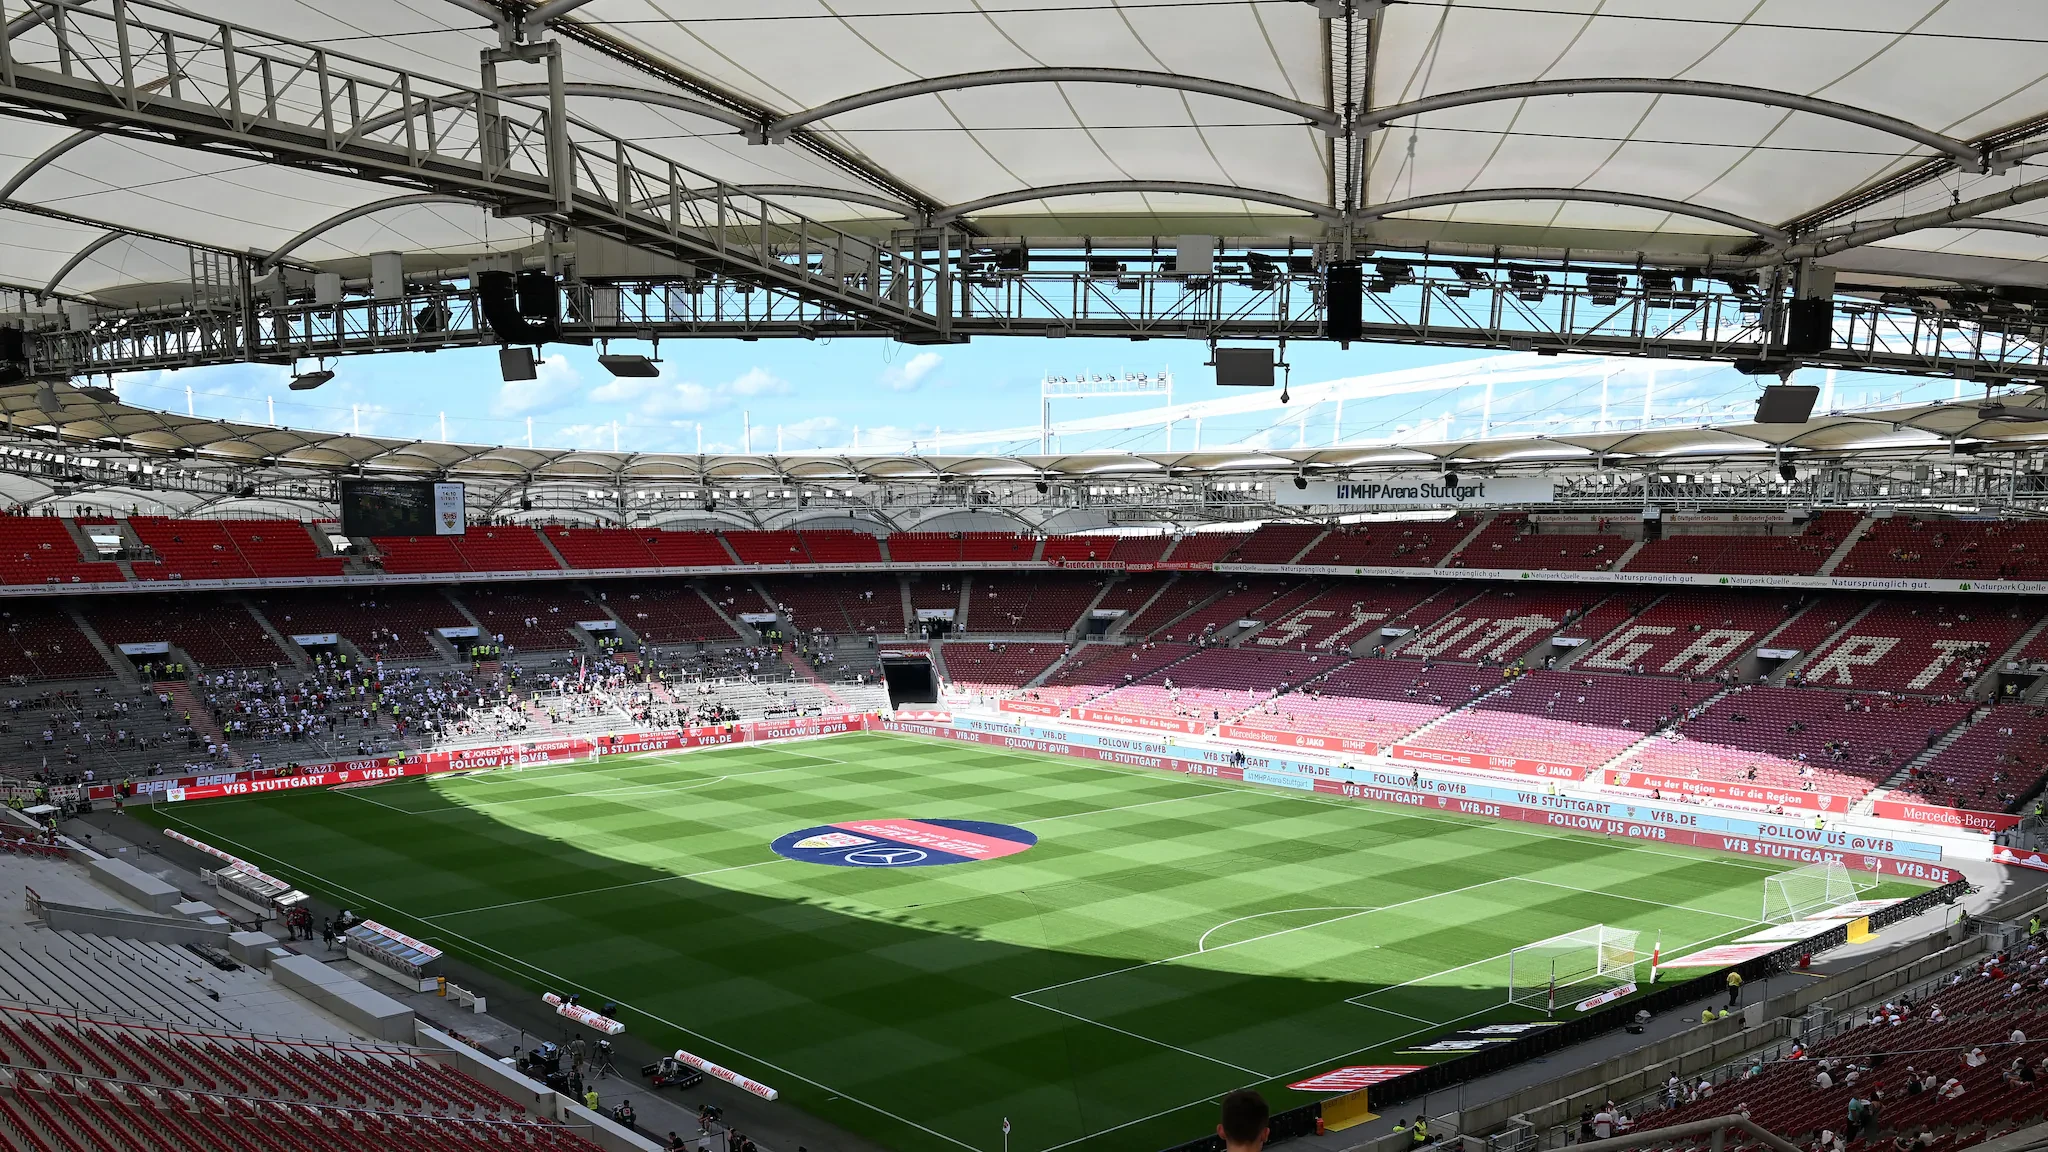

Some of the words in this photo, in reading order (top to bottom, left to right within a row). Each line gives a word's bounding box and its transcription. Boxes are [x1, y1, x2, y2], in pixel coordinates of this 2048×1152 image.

[1351, 484, 1381, 499] MHP
[1381, 484, 1418, 499] Arena
[1420, 482, 1485, 501] Stuttgart
[1280, 566, 1326, 574] Natursprünglich
[1433, 569, 1487, 578] Natursprünglich
[1531, 571, 1560, 579] Naturpark
[1560, 571, 1580, 579] Quelle
[1614, 573, 1677, 583] Natursprünglich
[1679, 575, 1696, 583] gut.
[1730, 576, 1765, 585] Naturpark
[1765, 576, 1790, 585] Quelle
[1831, 579, 1908, 589] Natursprünglich
[1911, 580, 1931, 590] gut.
[1973, 582, 2016, 592] Naturpark
[2017, 583, 2047, 592] Quelle
[1007, 704, 1051, 714] PORSCHE
[883, 722, 899, 730] VfB
[901, 724, 936, 735] STUTTGART
[971, 721, 982, 729] VfB
[984, 723, 1021, 734] STUTTGART
[1114, 715, 1133, 725] Region
[1140, 717, 1149, 726] für
[1159, 720, 1180, 730] Region
[767, 727, 806, 738] FOLLOW
[809, 725, 820, 734] US
[823, 723, 847, 733] @VfB
[956, 731, 979, 742] VfB.DE
[1042, 730, 1067, 741] VfB.DE
[1229, 728, 1278, 742] Mercedes-Benz
[611, 740, 668, 754] STUTTGART
[698, 735, 732, 745] VfB.DE
[1005, 737, 1035, 748] FOLLOW
[1037, 742, 1047, 750] US
[1049, 744, 1069, 754] @VfB
[1098, 738, 1131, 749] FOLLOW
[1132, 741, 1143, 750] US
[1145, 743, 1167, 753] @VfB
[1306, 738, 1325, 747] JAKO
[472, 747, 515, 759] JOKERSTAR
[1099, 751, 1112, 760] VfB
[1115, 753, 1161, 767] STUTTGART
[1203, 751, 1218, 761] VfB
[1403, 750, 1471, 764] PORSCHE
[350, 760, 376, 770] GAZI
[449, 757, 497, 770] FOLLOW
[521, 752, 549, 763] @VfB
[363, 766, 404, 779] VfB.DE
[1188, 763, 1218, 776] VfB.DE
[1298, 764, 1330, 776] VfB.DE
[1548, 766, 1573, 777] JAKO
[223, 783, 247, 794] VfB
[251, 775, 324, 792] STUTTGART
[1267, 775, 1282, 783] Arena
[1283, 777, 1308, 787] Stuttgart
[1420, 779, 1434, 790] US
[1437, 783, 1467, 794] @VfB
[1342, 784, 1360, 796] VfB
[1363, 788, 1425, 805] STUTTGART
[1643, 777, 1662, 787] Aus
[1664, 780, 1680, 789] der
[1682, 782, 1716, 795] Region
[1729, 787, 1746, 798] für
[1747, 788, 1764, 800] die
[1766, 791, 1802, 805] Region
[1460, 801, 1500, 816] VfB.DE
[1517, 793, 1538, 804] VfB
[1542, 796, 1611, 814] STUTTGART
[1651, 810, 1697, 826] VfB.DE
[1903, 807, 1996, 828] Mercedes-Benz
[1548, 813, 1603, 830] FOLLOW
[1607, 822, 1624, 834] US
[1628, 825, 1666, 839] @VfB
[1759, 825, 1822, 842] FOLLOW
[1827, 833, 1846, 845] US
[1852, 838, 1894, 852] @VfB
[1723, 838, 1749, 852] VfB
[1754, 842, 1843, 864] STUTTGART
[1896, 862, 1949, 882] VfB.DE
